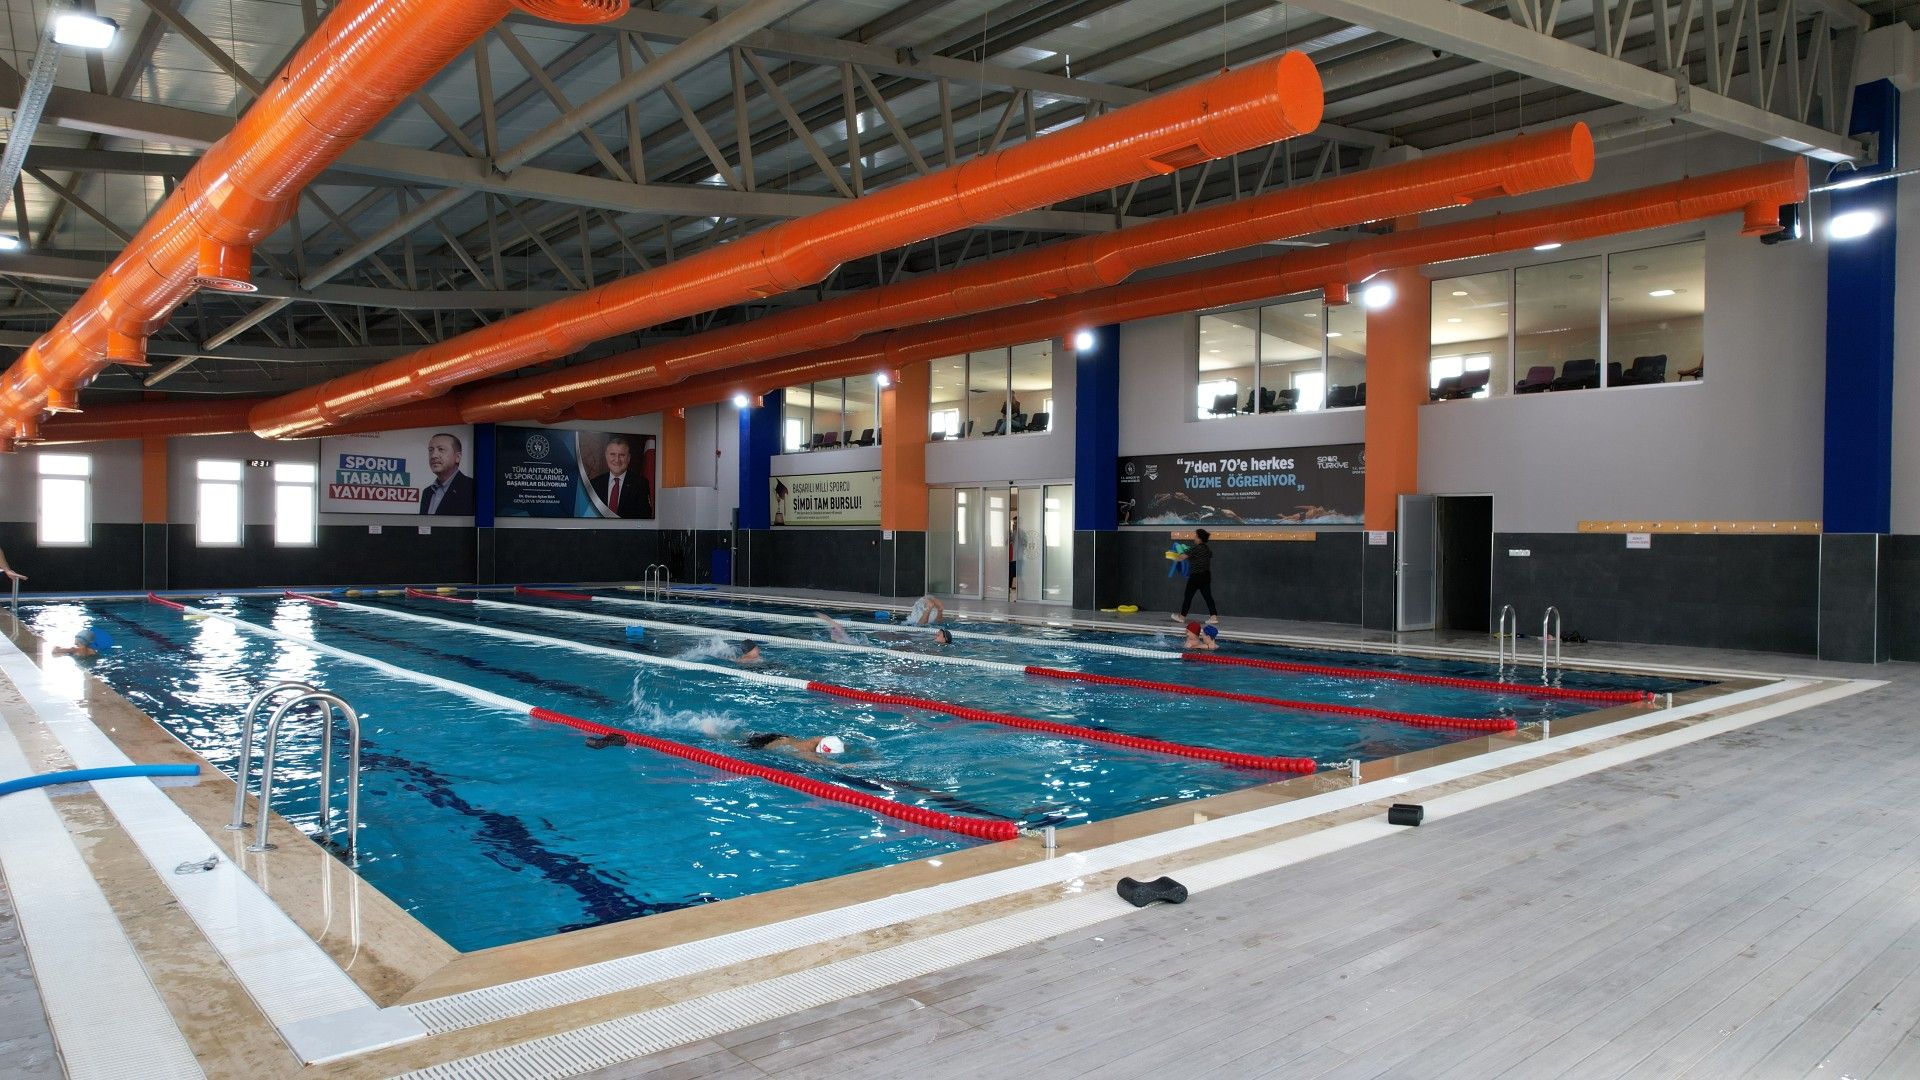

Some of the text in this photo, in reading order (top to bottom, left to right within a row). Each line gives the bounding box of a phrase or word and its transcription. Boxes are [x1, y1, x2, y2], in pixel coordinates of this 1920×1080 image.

[345, 455, 398, 472] SPORU
[512, 465, 563, 475] TÜM ANTRENÖR
[1251, 456, 1295, 471] herkes
[341, 471, 404, 486] TABANA
[504, 472, 570, 482] VE SPORCULARIMIZA
[1184, 475, 1222, 489] YÜZME
[331, 485, 417, 501] YAYIYORUZ
[814, 497, 829, 510] TAM
[830, 495, 862, 510] BURSLU!
